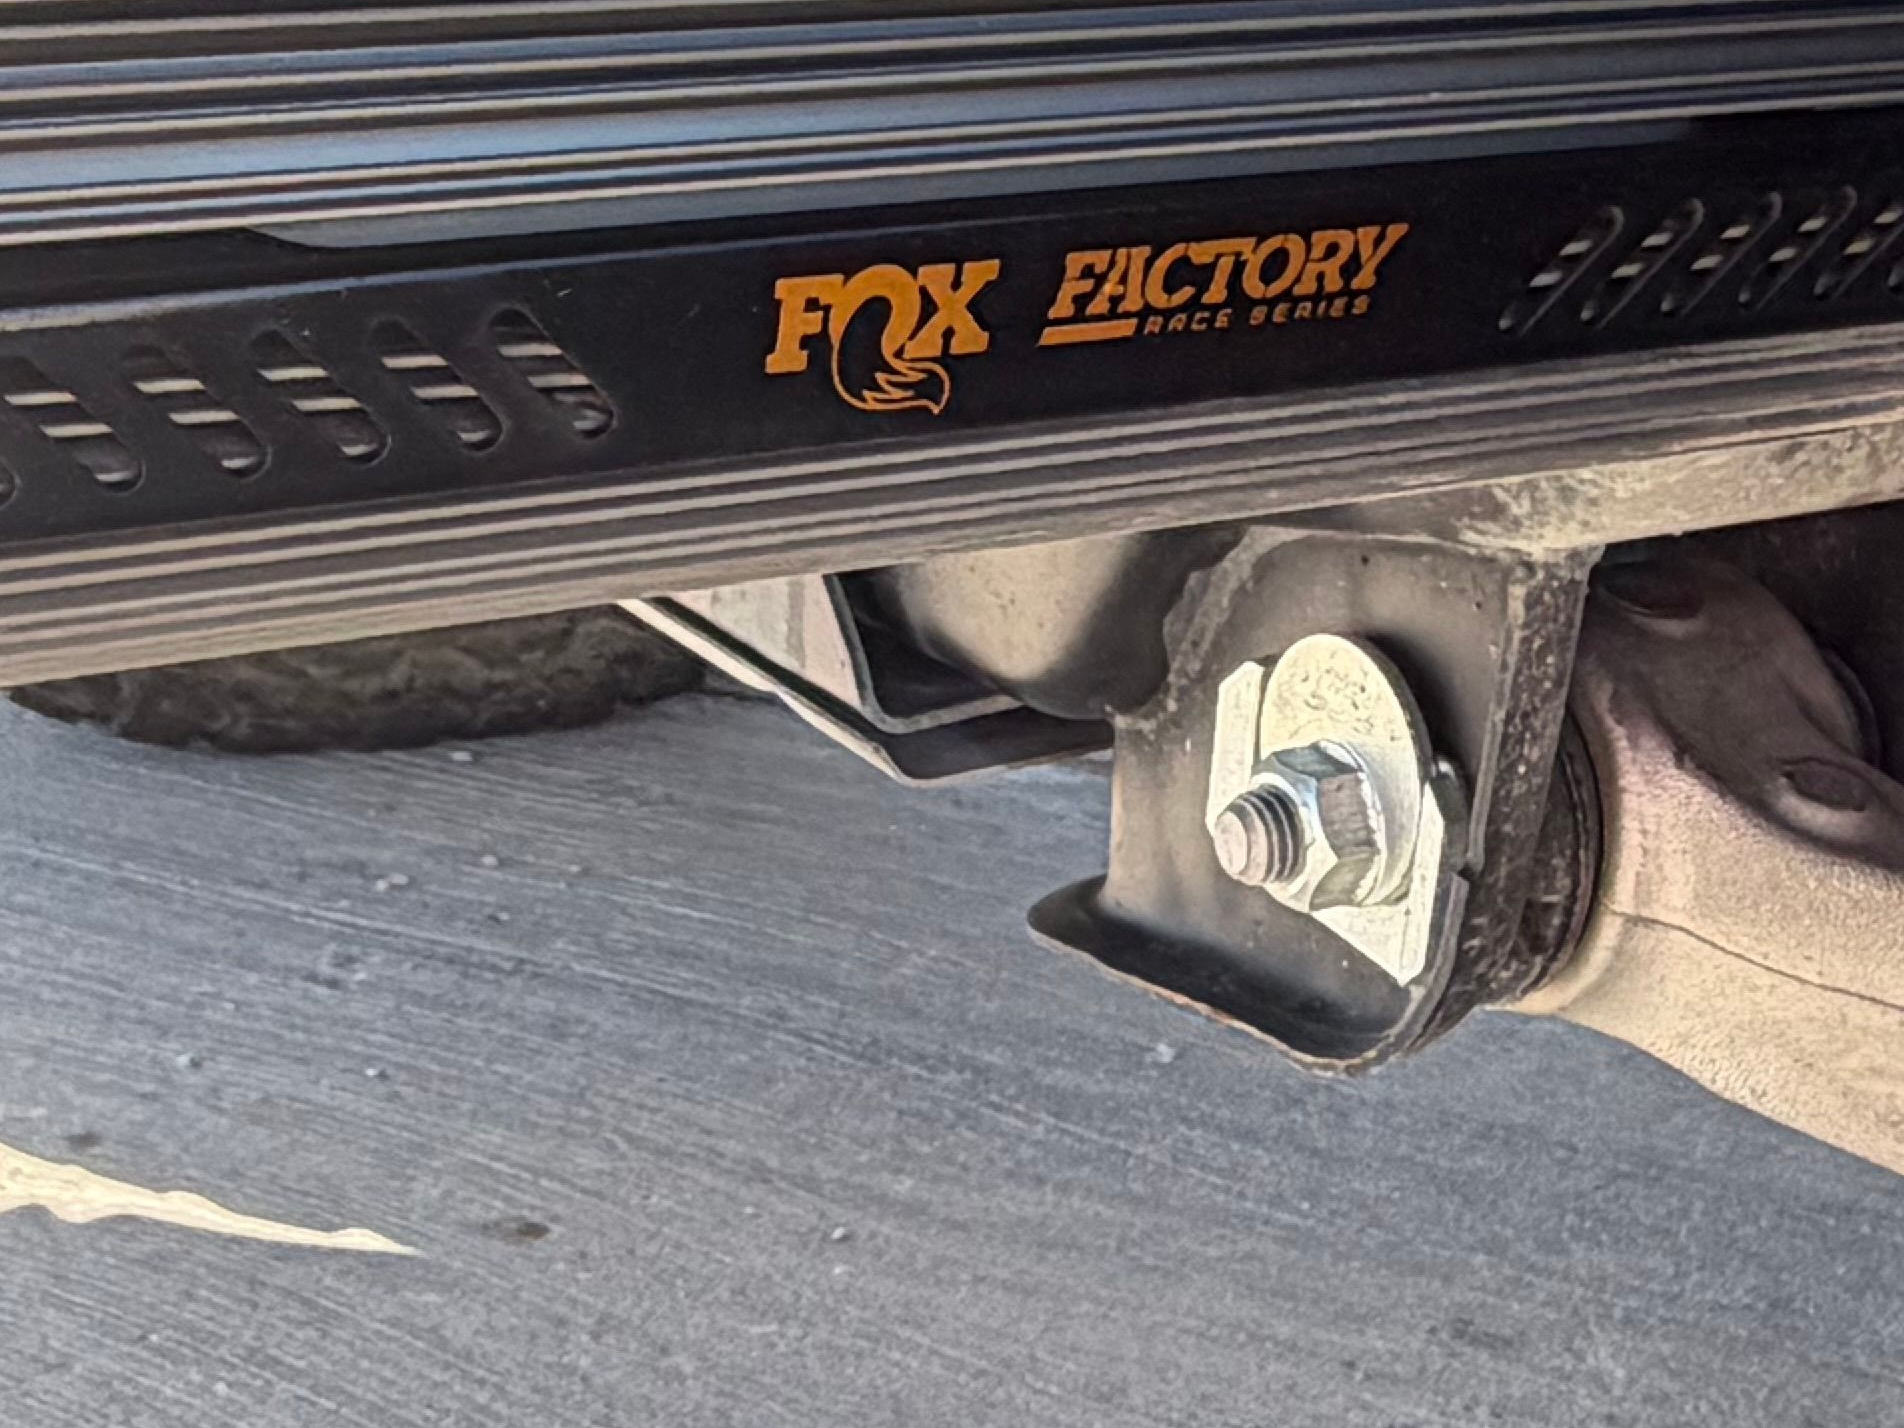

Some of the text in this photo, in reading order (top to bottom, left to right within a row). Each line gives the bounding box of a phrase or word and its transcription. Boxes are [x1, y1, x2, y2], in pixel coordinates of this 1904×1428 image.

[764, 222, 1409, 413] FOX FACTORY
[1143, 293, 1372, 337] RACE SERIES
